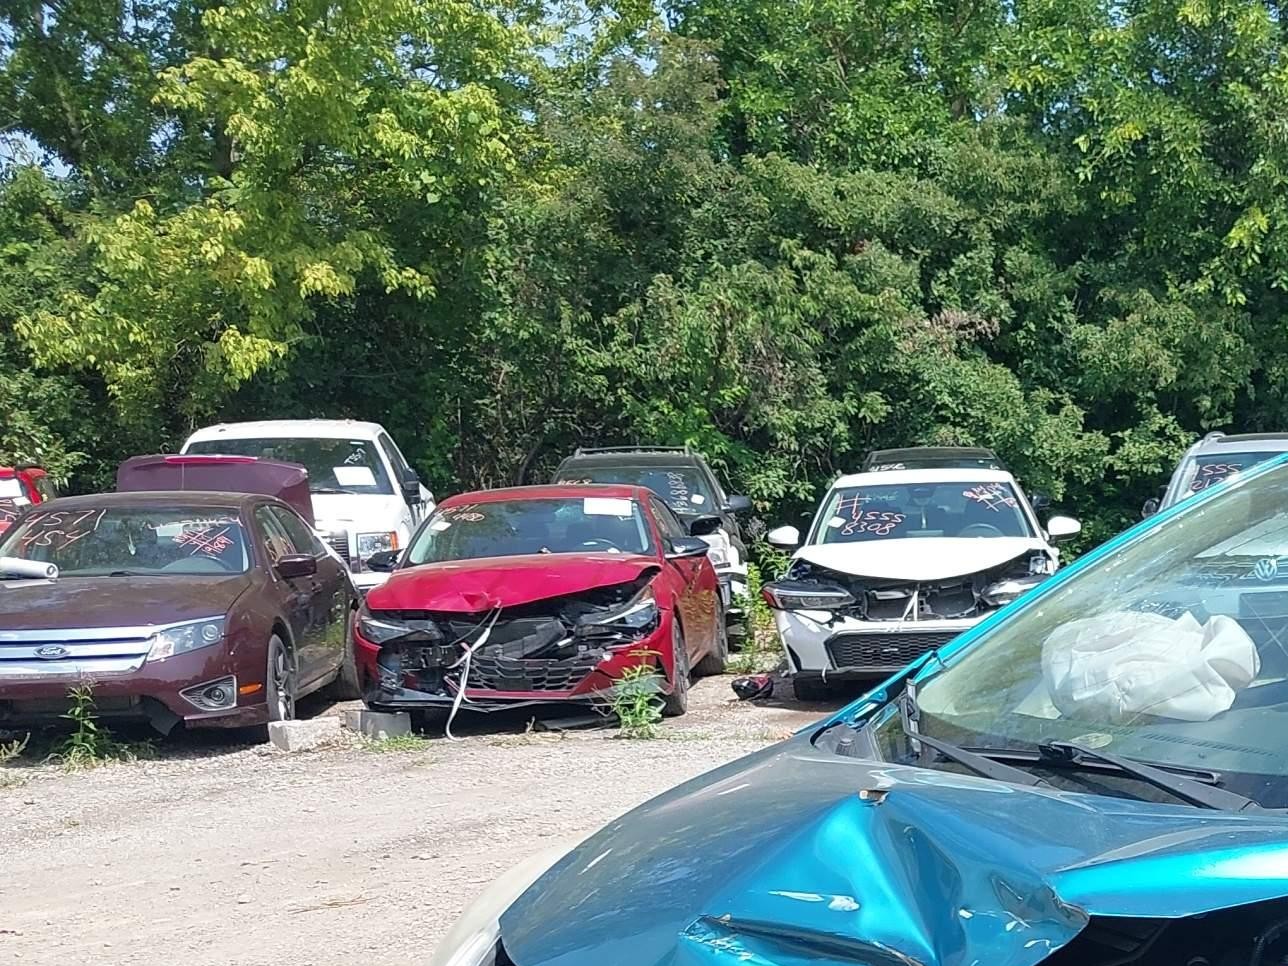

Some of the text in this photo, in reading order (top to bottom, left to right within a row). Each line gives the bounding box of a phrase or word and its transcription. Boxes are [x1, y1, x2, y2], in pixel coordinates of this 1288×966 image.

[24, 508, 108, 531] 4571
[852, 510, 907, 523] 4555
[840, 521, 896, 536] 8308
[21, 528, 91, 551] 454
